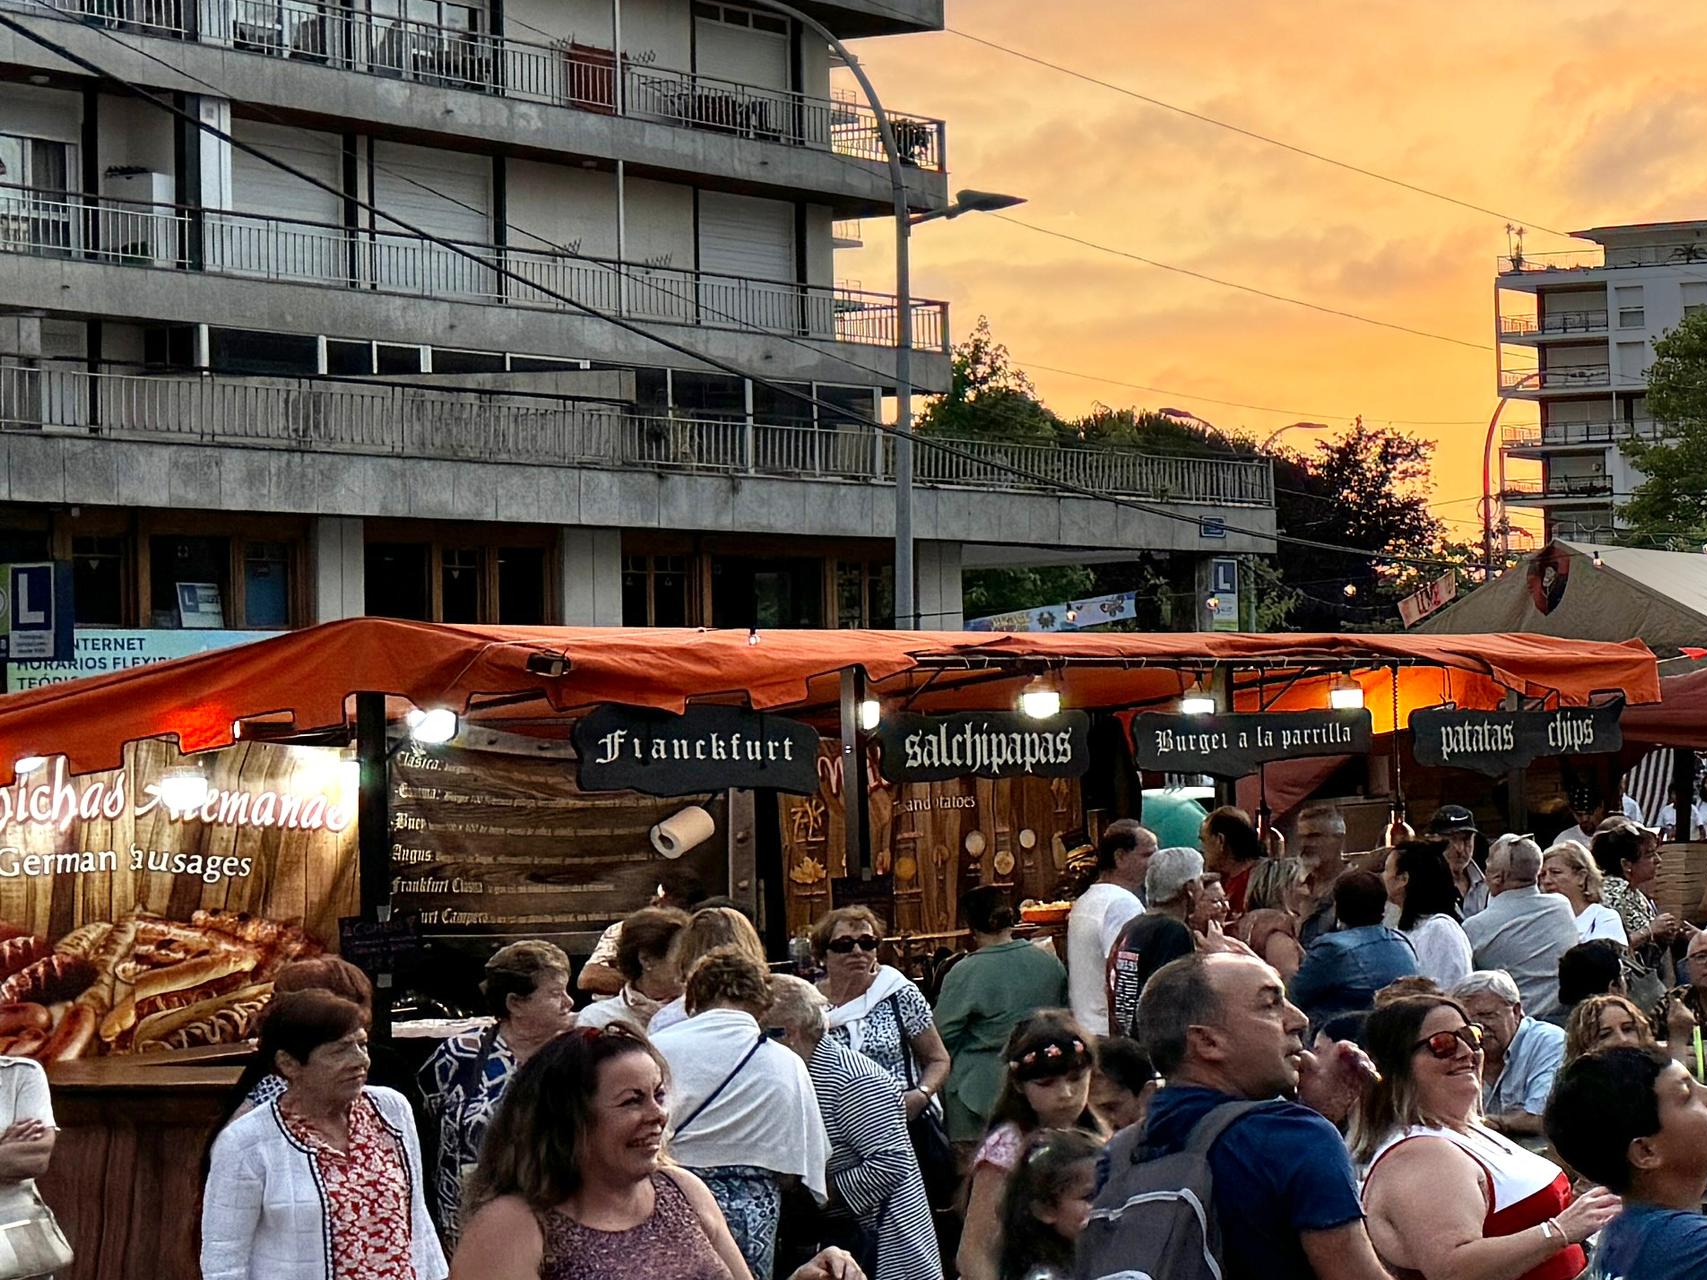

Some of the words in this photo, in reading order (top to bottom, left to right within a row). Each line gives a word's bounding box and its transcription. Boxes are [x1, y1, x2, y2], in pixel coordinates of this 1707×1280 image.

[18, 573, 45, 624] L
[904, 720, 1073, 774] salchipapas
[1155, 728, 1228, 757] Burger
[1238, 731, 1249, 749] a
[1256, 725, 1273, 748] la
[1282, 721, 1351, 750] parrilla
[1440, 719, 1515, 760] patatas
[1547, 711, 1594, 752] chips
[0, 847, 118, 878] German
